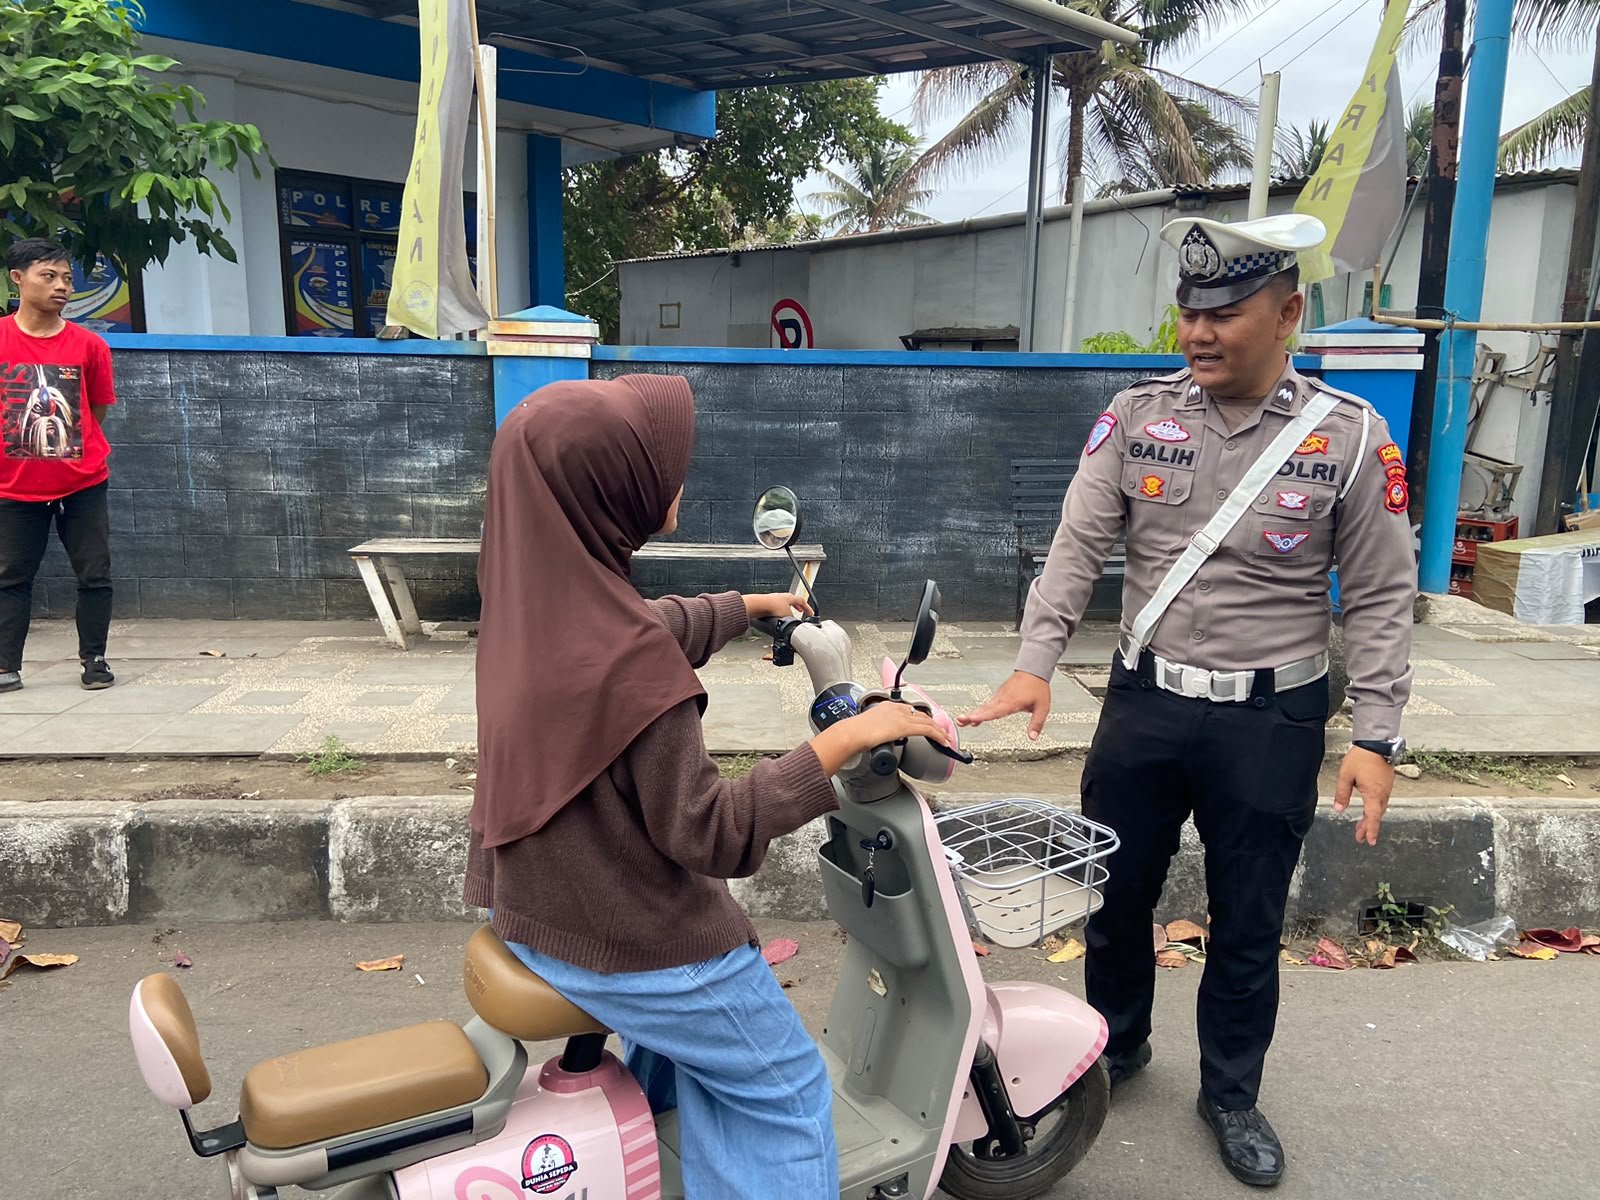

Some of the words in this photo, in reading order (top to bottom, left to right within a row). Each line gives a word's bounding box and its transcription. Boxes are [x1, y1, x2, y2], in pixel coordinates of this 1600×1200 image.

[335, 250, 348, 307] POLRES
[1129, 441, 1194, 466] GALIH
[1277, 460, 1336, 482] OLRI
[525, 1174, 549, 1187] DUNIA
[549, 1164, 574, 1178] SEPEDA
